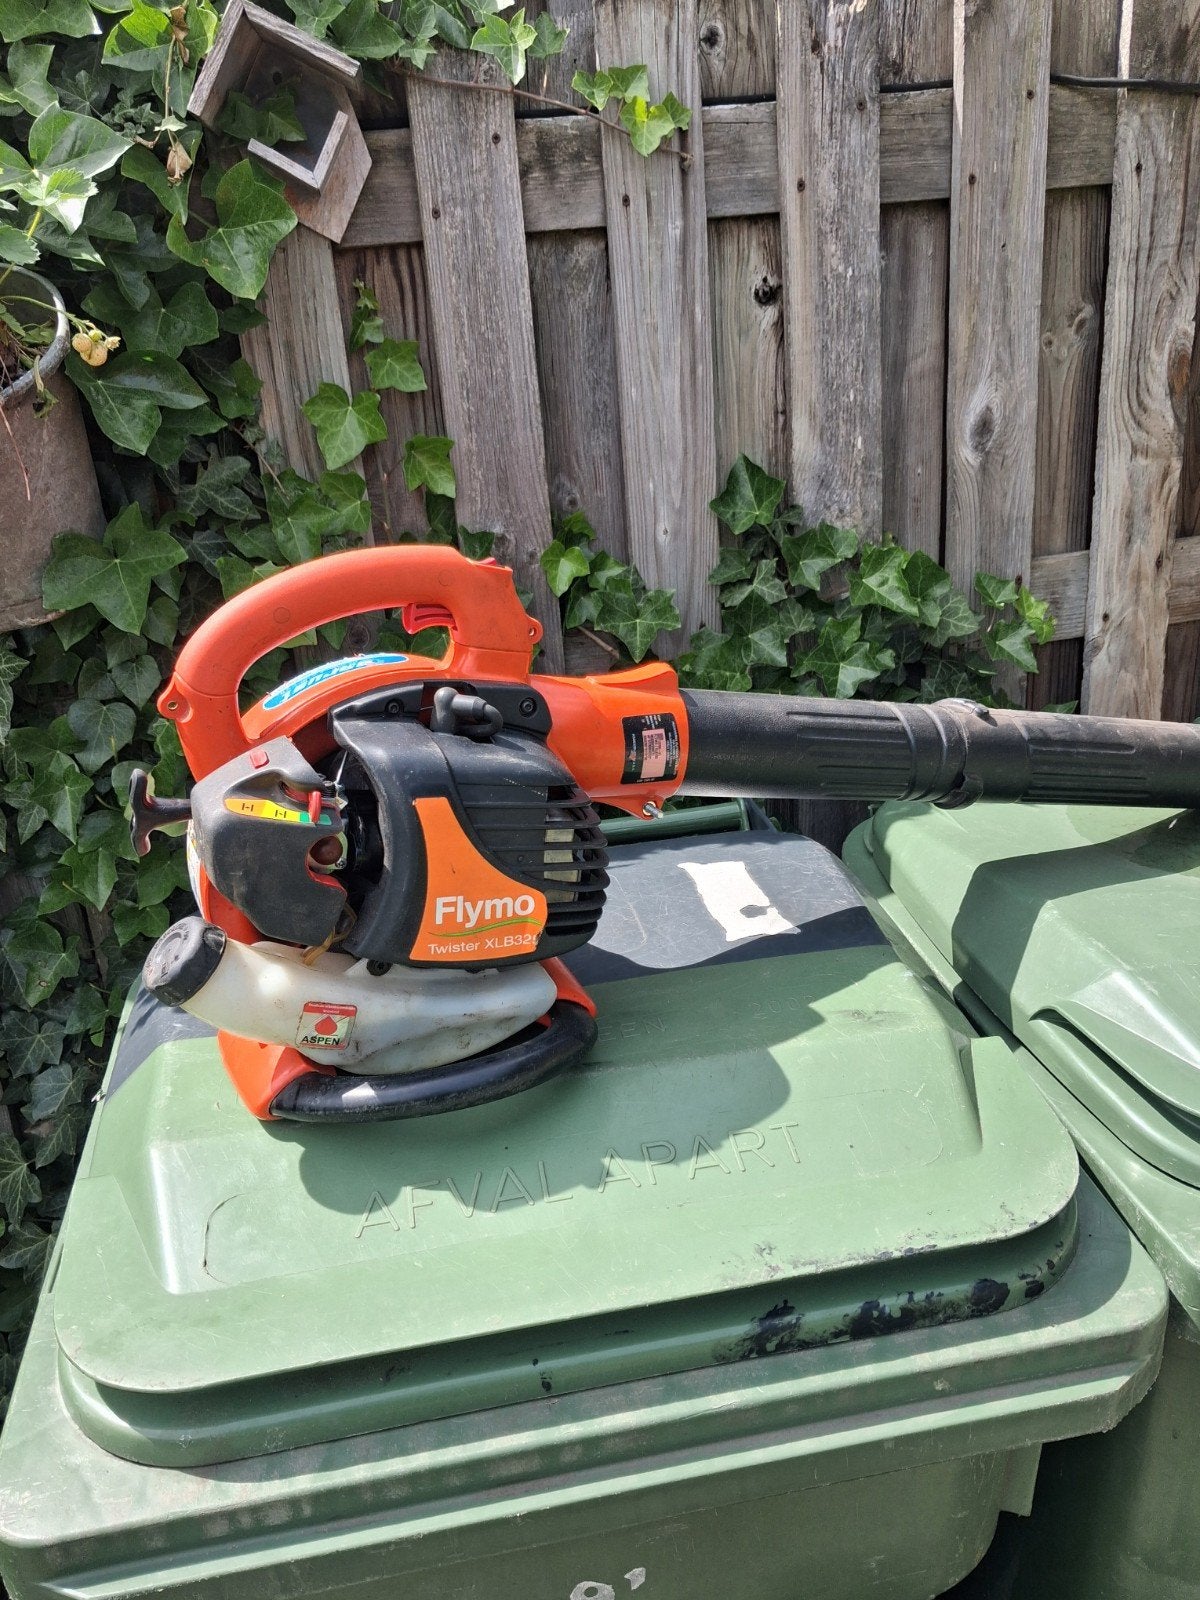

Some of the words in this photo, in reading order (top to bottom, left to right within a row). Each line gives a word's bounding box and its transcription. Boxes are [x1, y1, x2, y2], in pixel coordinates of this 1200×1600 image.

[435, 894, 535, 928] Flymo
[428, 942, 480, 954] Twister
[302, 1035, 341, 1046] ASPEN
[354, 1160, 574, 1239] AFVAL
[597, 1121, 802, 1194] APART
